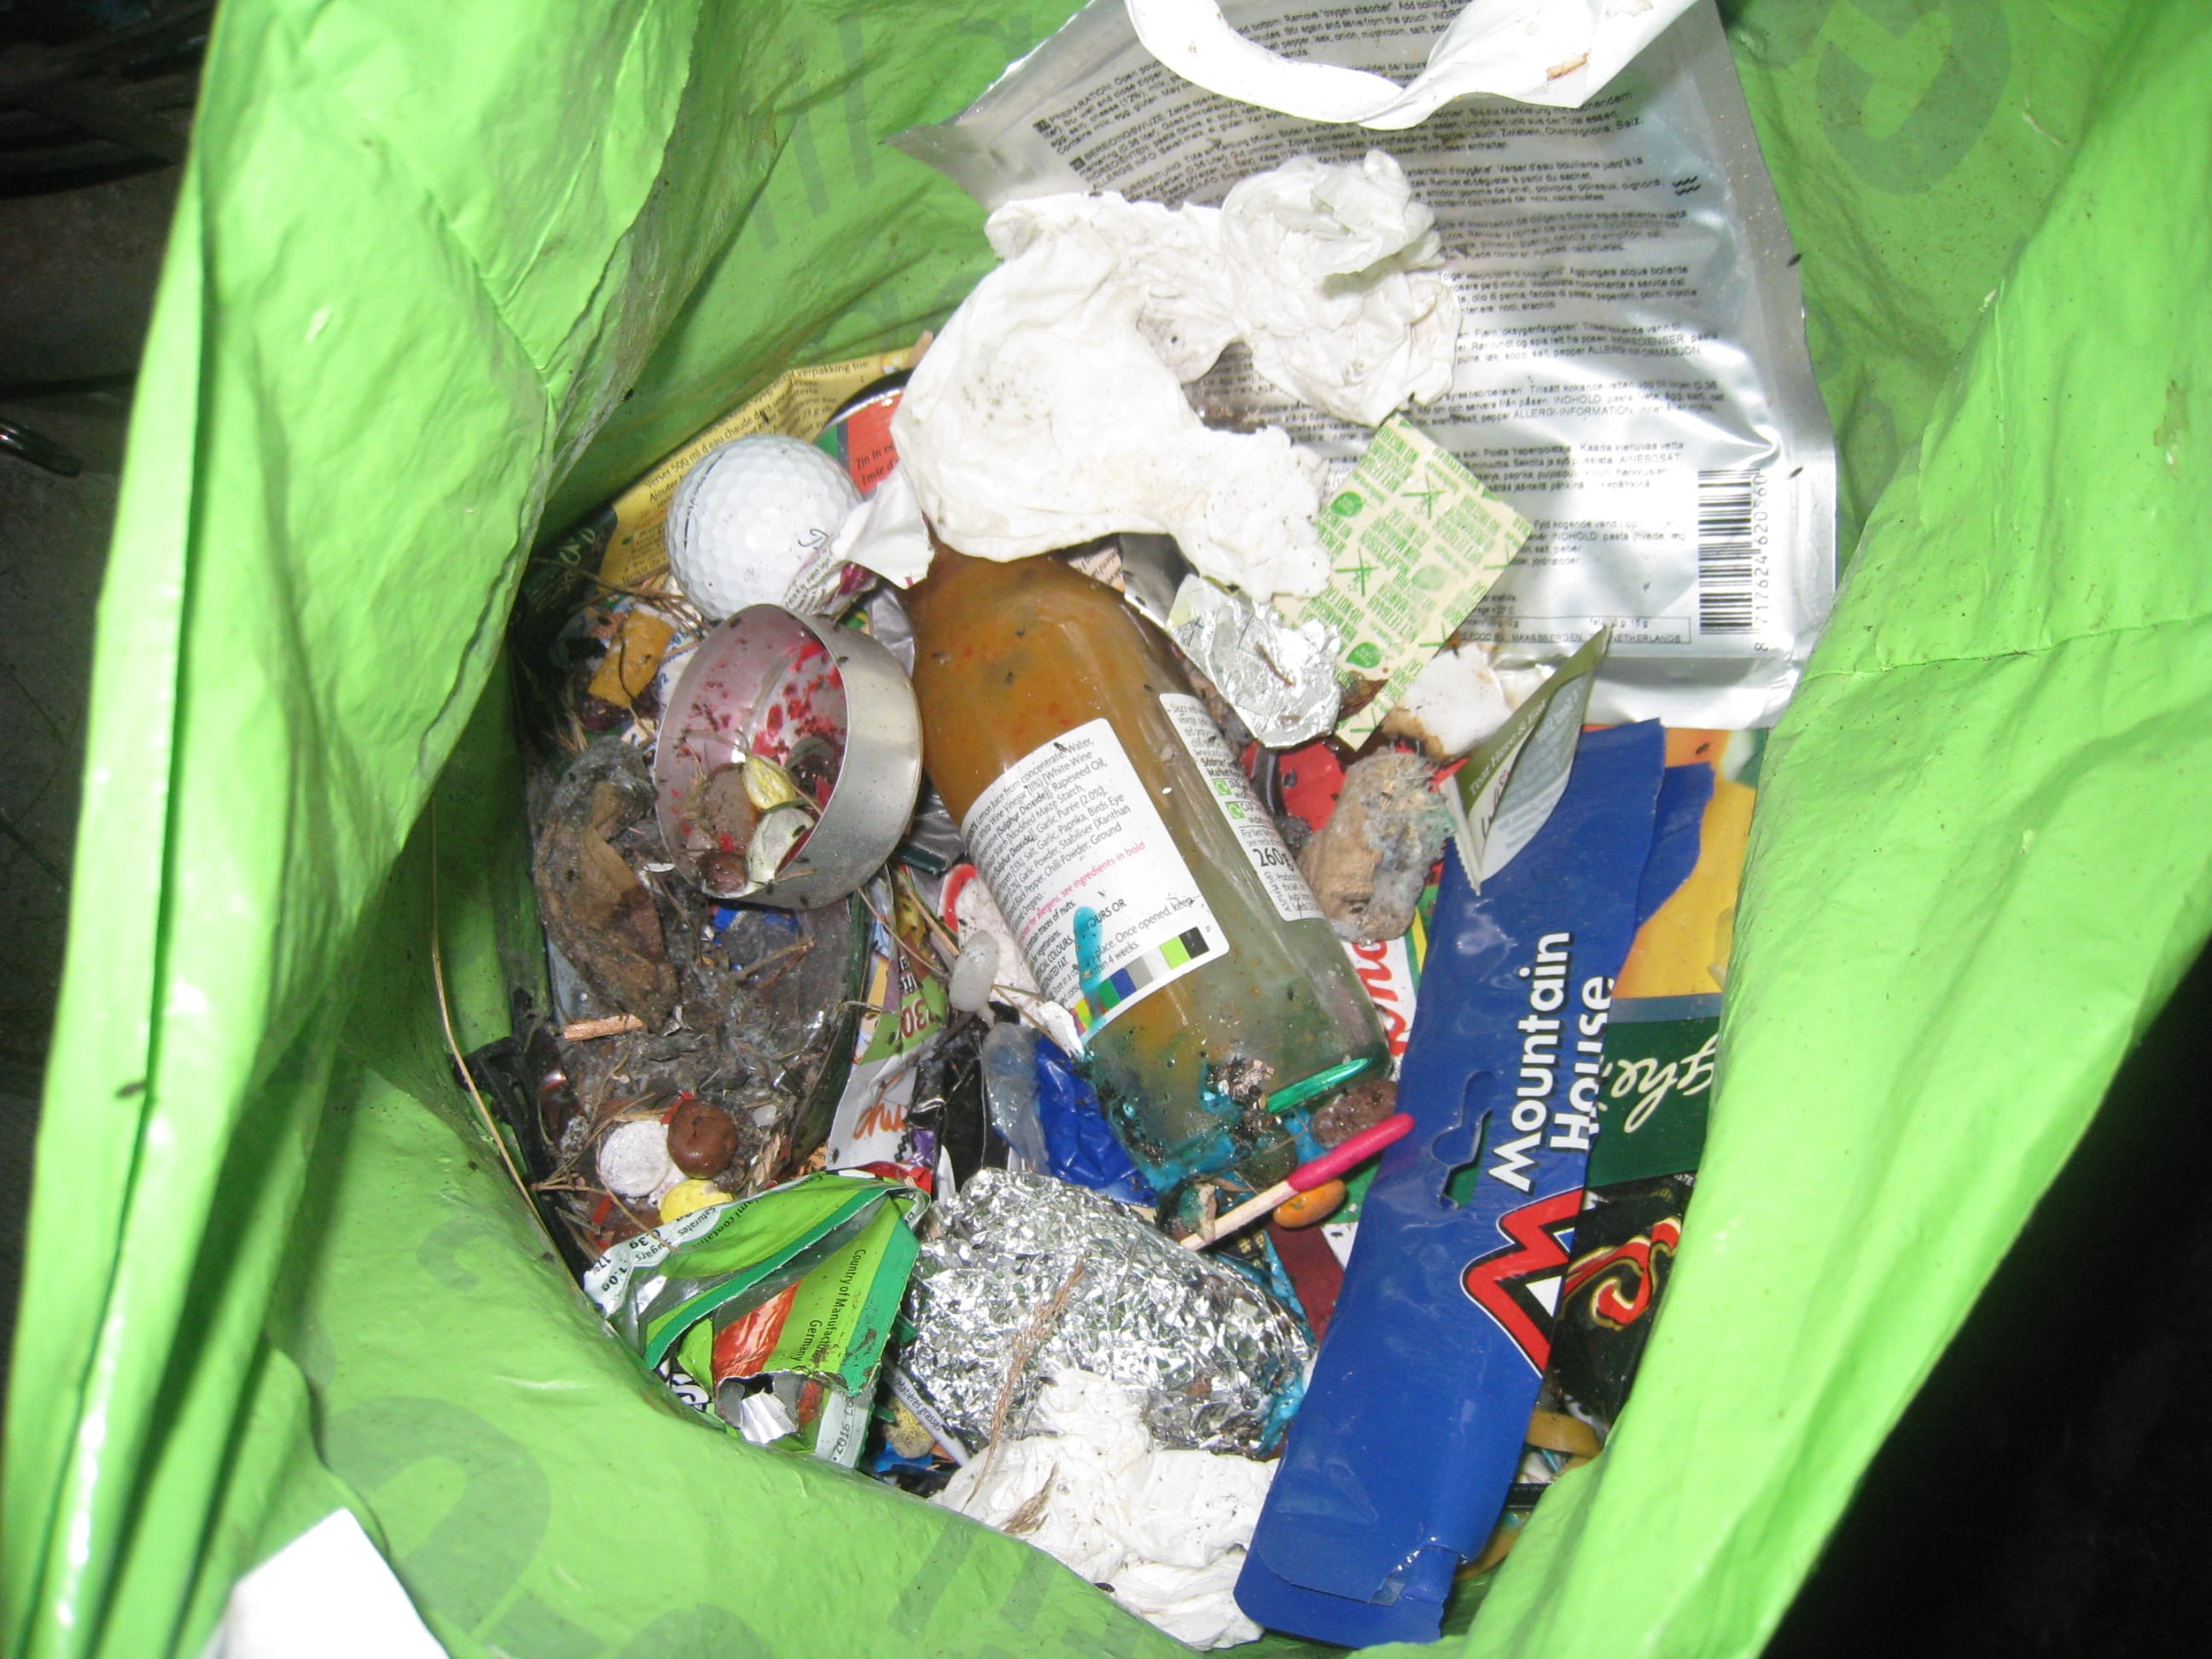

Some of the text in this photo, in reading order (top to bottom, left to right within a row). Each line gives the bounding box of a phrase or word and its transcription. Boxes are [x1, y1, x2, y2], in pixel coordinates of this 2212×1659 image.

[671, 457, 689, 473] 500
[690, 450, 701, 463] ml
[725, 415, 755, 439] chaude
[872, 450, 882, 460] in
[1052, 764, 1091, 793] Rapeseed
[1090, 822, 1124, 847] Ground
[1073, 857, 1117, 889] ingredients
[1115, 851, 1126, 862] in
[1125, 841, 1148, 858] bold
[1253, 847, 1295, 873] 260g
[1111, 898, 1128, 914] OR
[1115, 924, 1139, 944] Once
[1138, 907, 1173, 932] opened,
[1171, 895, 1196, 914] keep
[1115, 941, 1141, 960] weeks.
[1487, 932, 1572, 1194] Mountain
[1550, 975, 1615, 1151] House
[678, 1206, 717, 1237] Saturates
[840, 1249, 868, 1293] Country of
[790, 1318, 824, 1364] Germany
